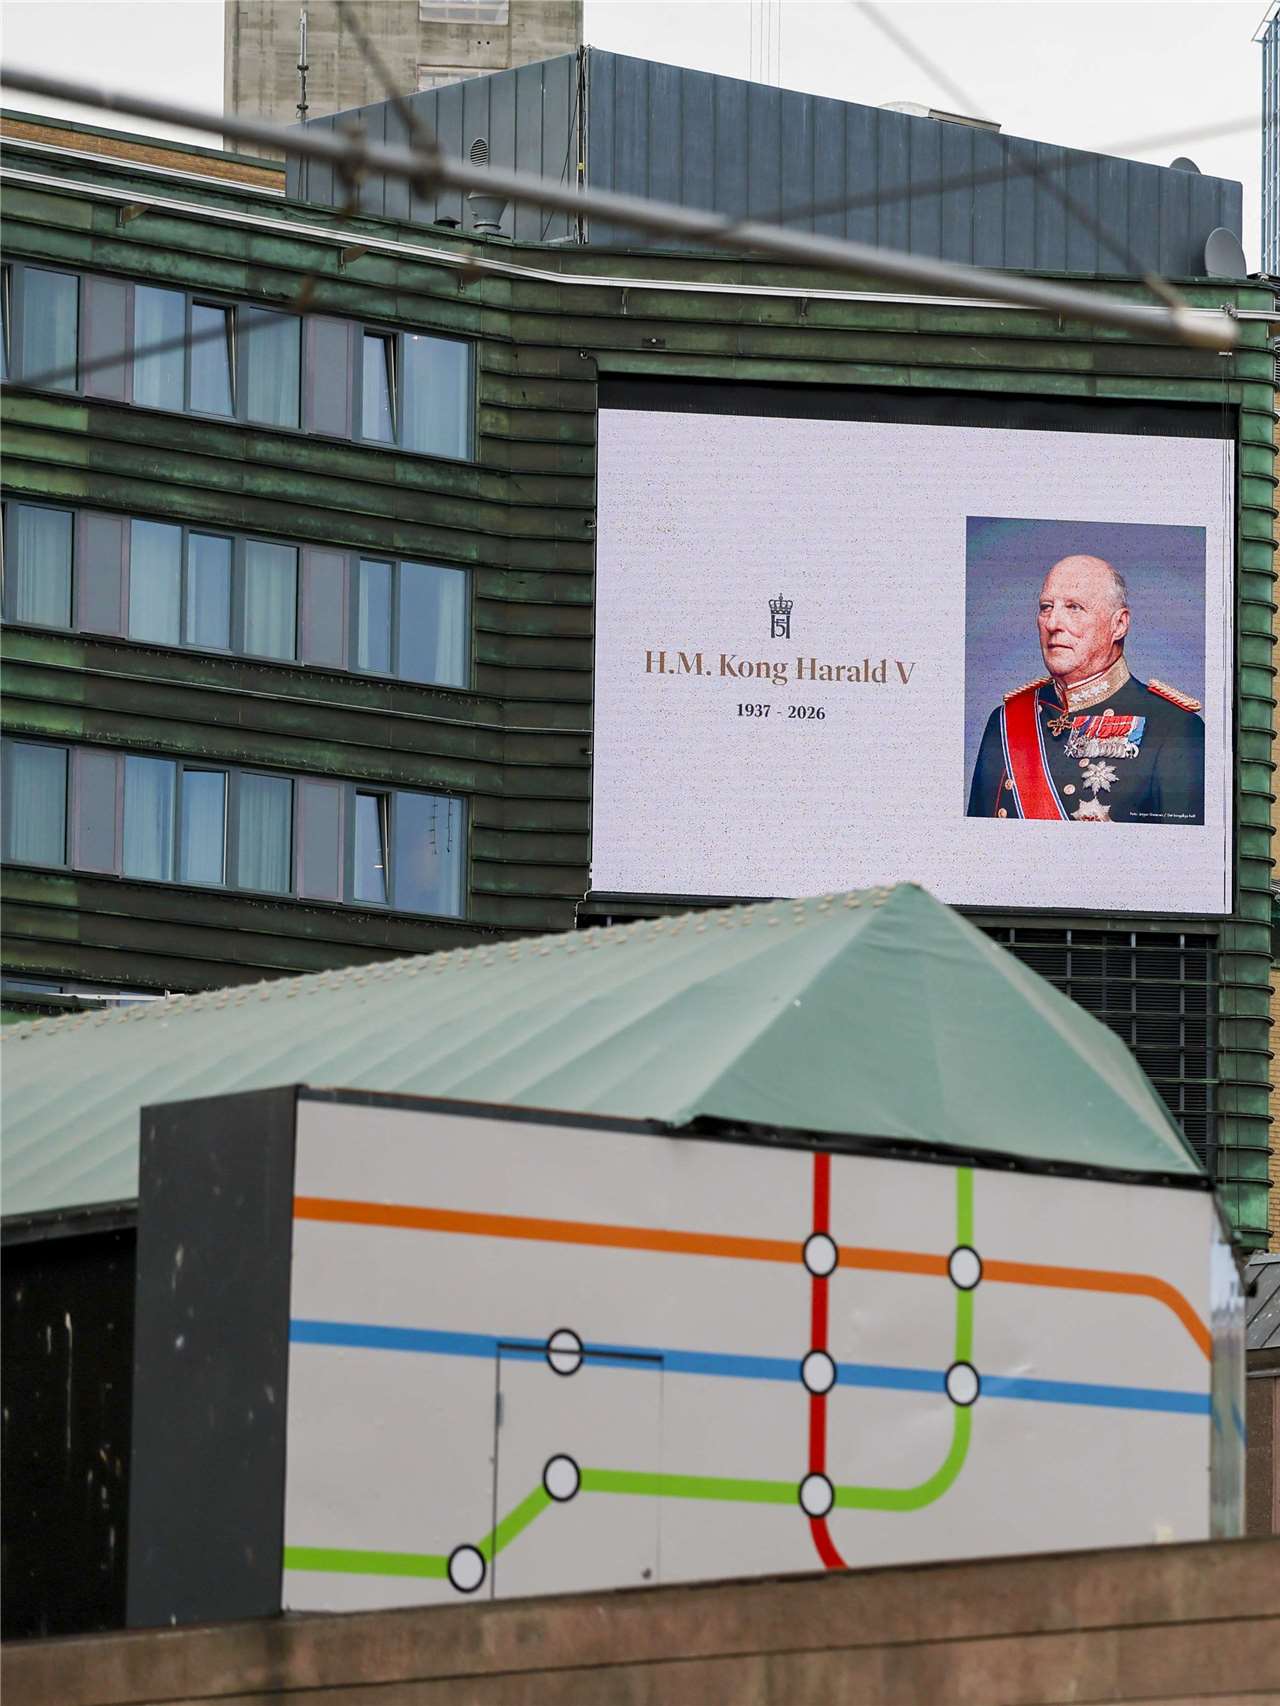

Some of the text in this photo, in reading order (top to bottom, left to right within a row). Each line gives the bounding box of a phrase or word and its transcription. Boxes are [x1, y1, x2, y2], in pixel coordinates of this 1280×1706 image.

[645, 650, 916, 686] H.M. Kong Harald V
[736, 703, 771, 718] 1937
[787, 705, 826, 720] 2026
